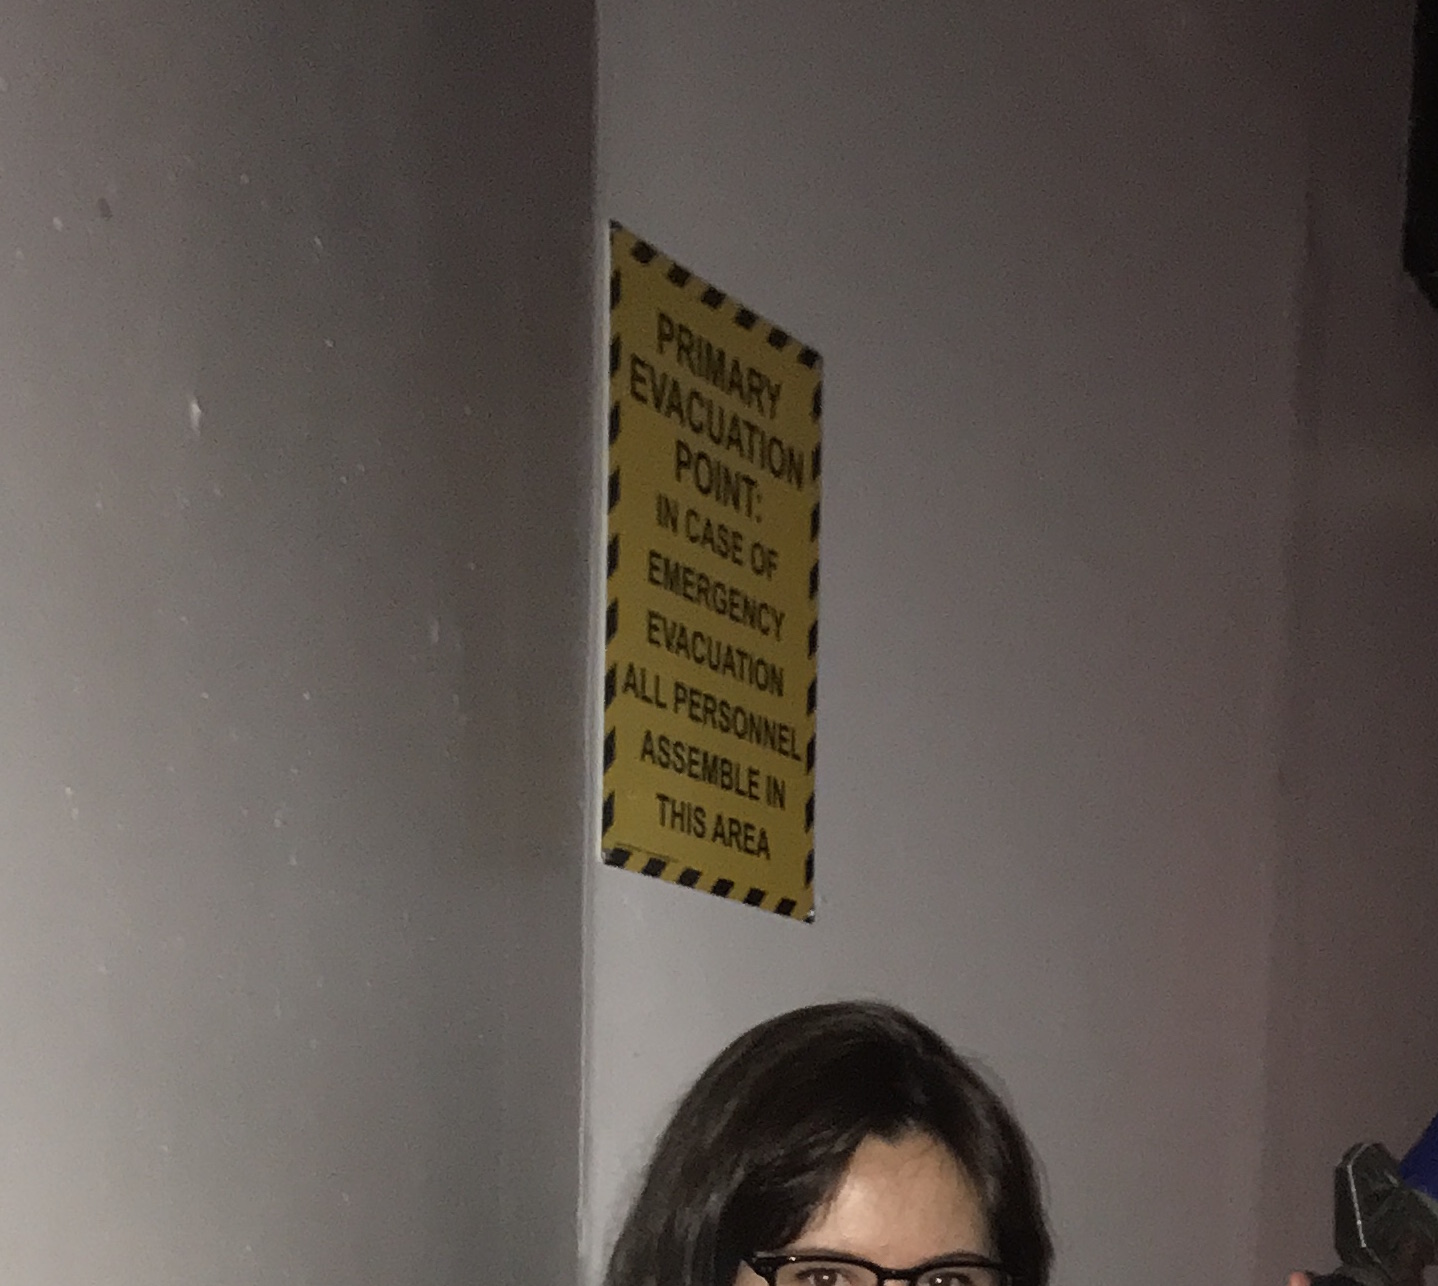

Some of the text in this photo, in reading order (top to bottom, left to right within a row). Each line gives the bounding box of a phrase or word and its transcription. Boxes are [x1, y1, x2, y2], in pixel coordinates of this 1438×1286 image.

[657, 312, 782, 420] PRIMARY
[629, 353, 805, 490] EVACUATION
[675, 439, 763, 524] POINT:
[656, 493, 778, 581] IN CASE OF
[648, 549, 786, 642] EMERGENCY
[647, 610, 784, 697] EVACUATION
[622, 662, 802, 762] ALL PERSONNEL
[640, 730, 786, 811] ASSEMBLE IN
[656, 793, 771, 861] THIS AREA
